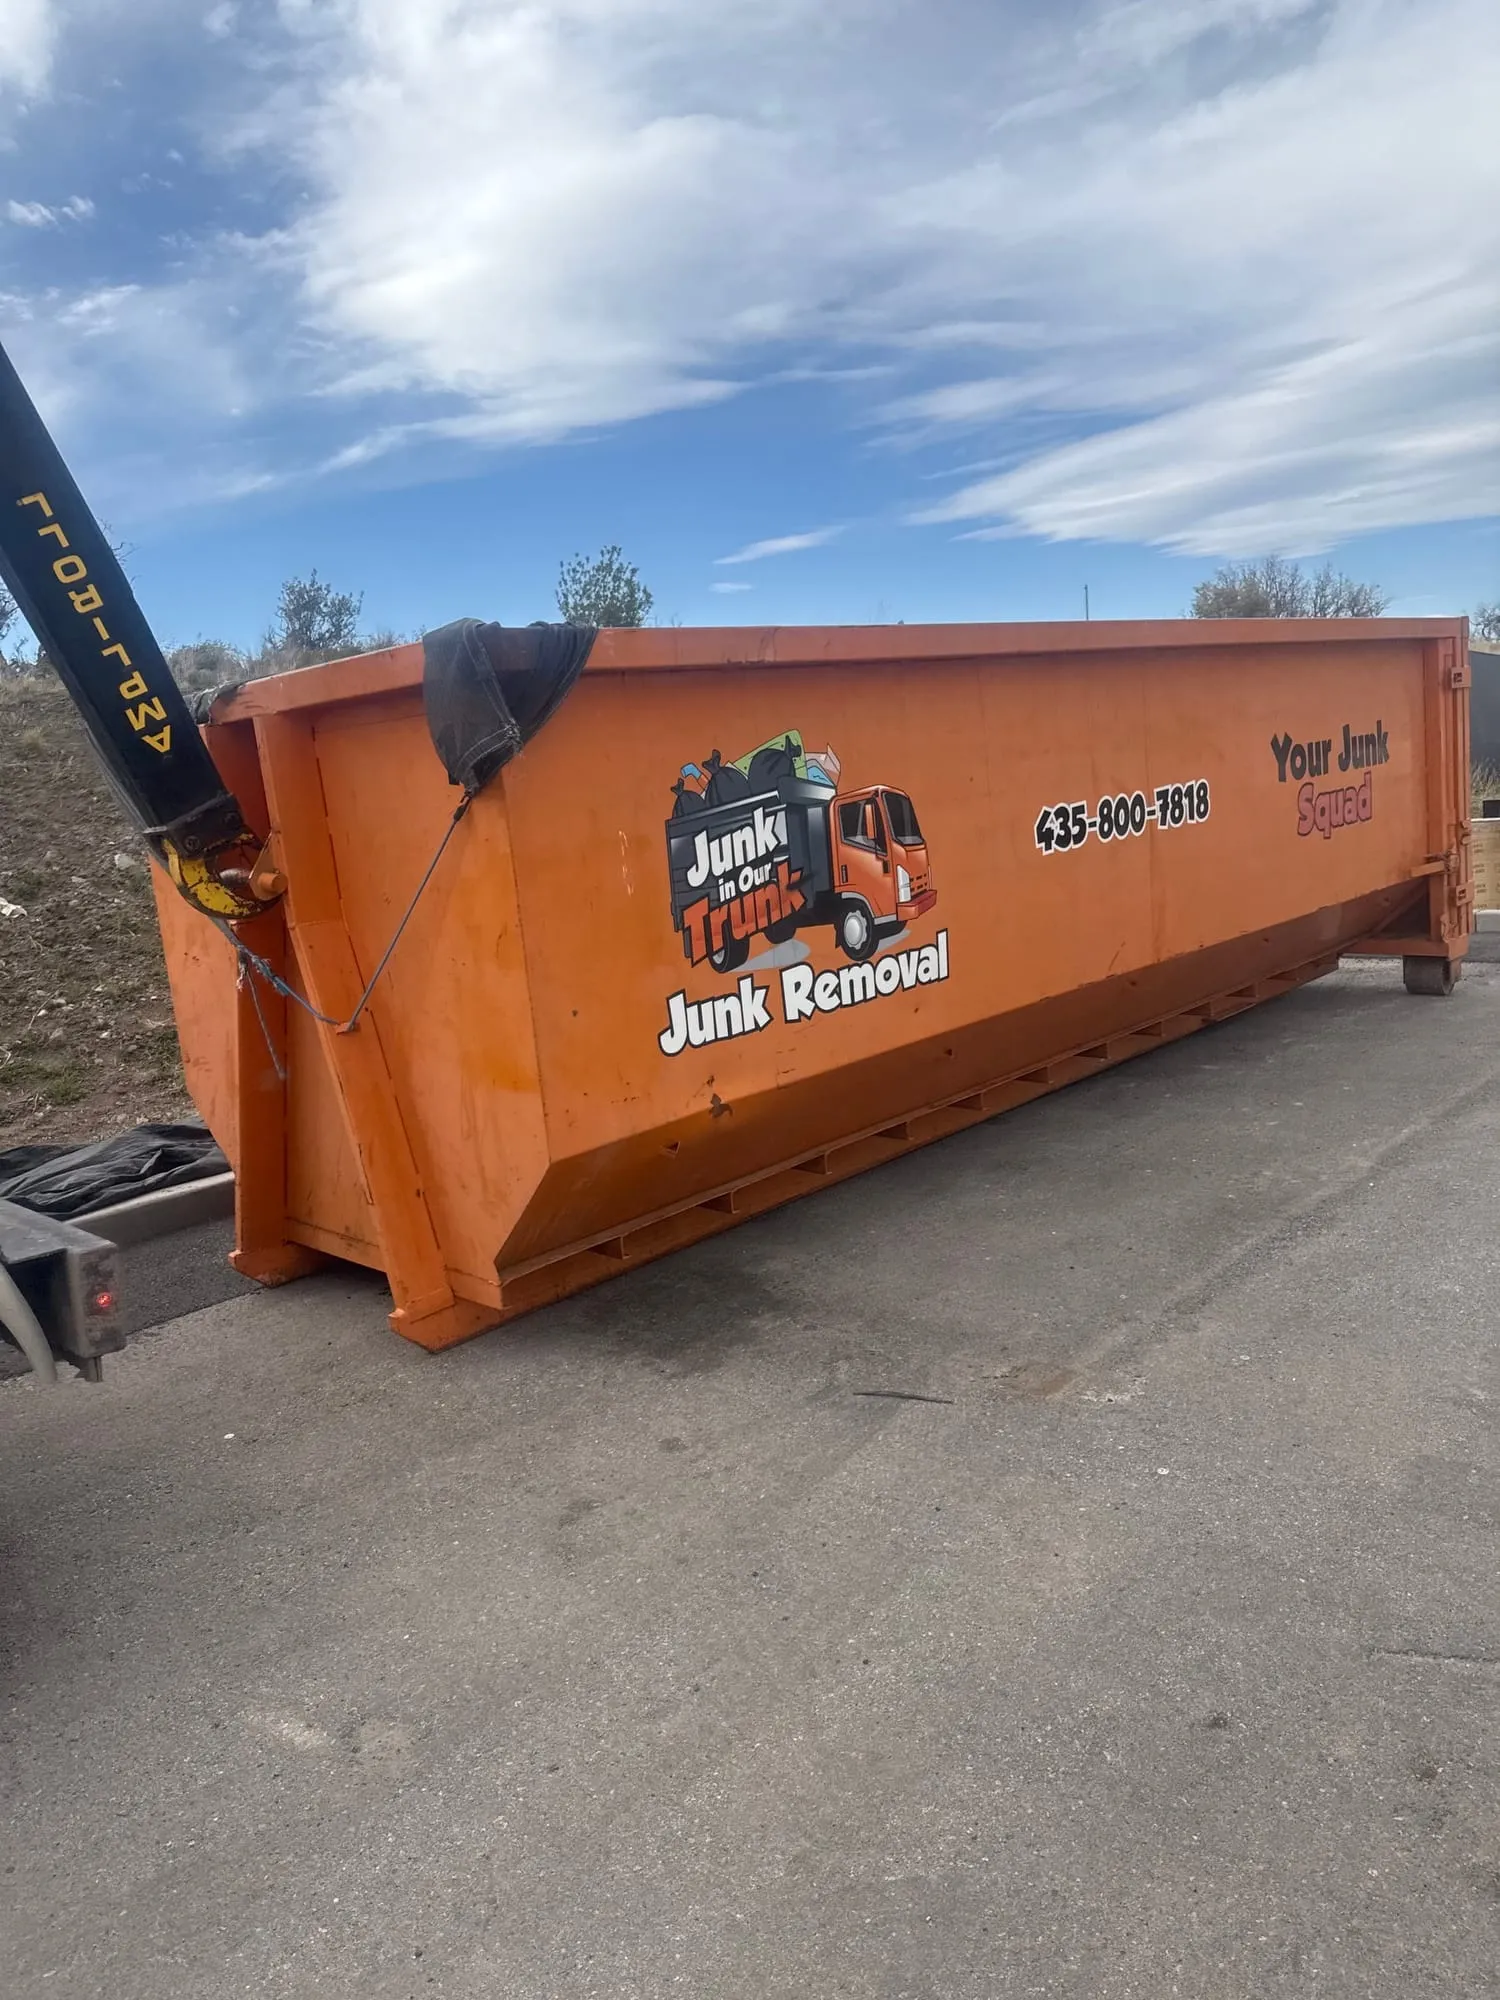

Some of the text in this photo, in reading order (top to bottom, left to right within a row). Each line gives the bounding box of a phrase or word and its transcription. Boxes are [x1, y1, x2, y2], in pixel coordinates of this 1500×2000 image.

[1270, 720, 1390, 783] Your Junk
[1034, 778, 1210, 856] 435-800-7818
[1297, 771, 1373, 840] Squad
[686, 806, 781, 888] Junk
[718, 864, 772, 903] in Our
[682, 864, 805, 966] Trunk
[658, 928, 950, 1057] Junk Removal
